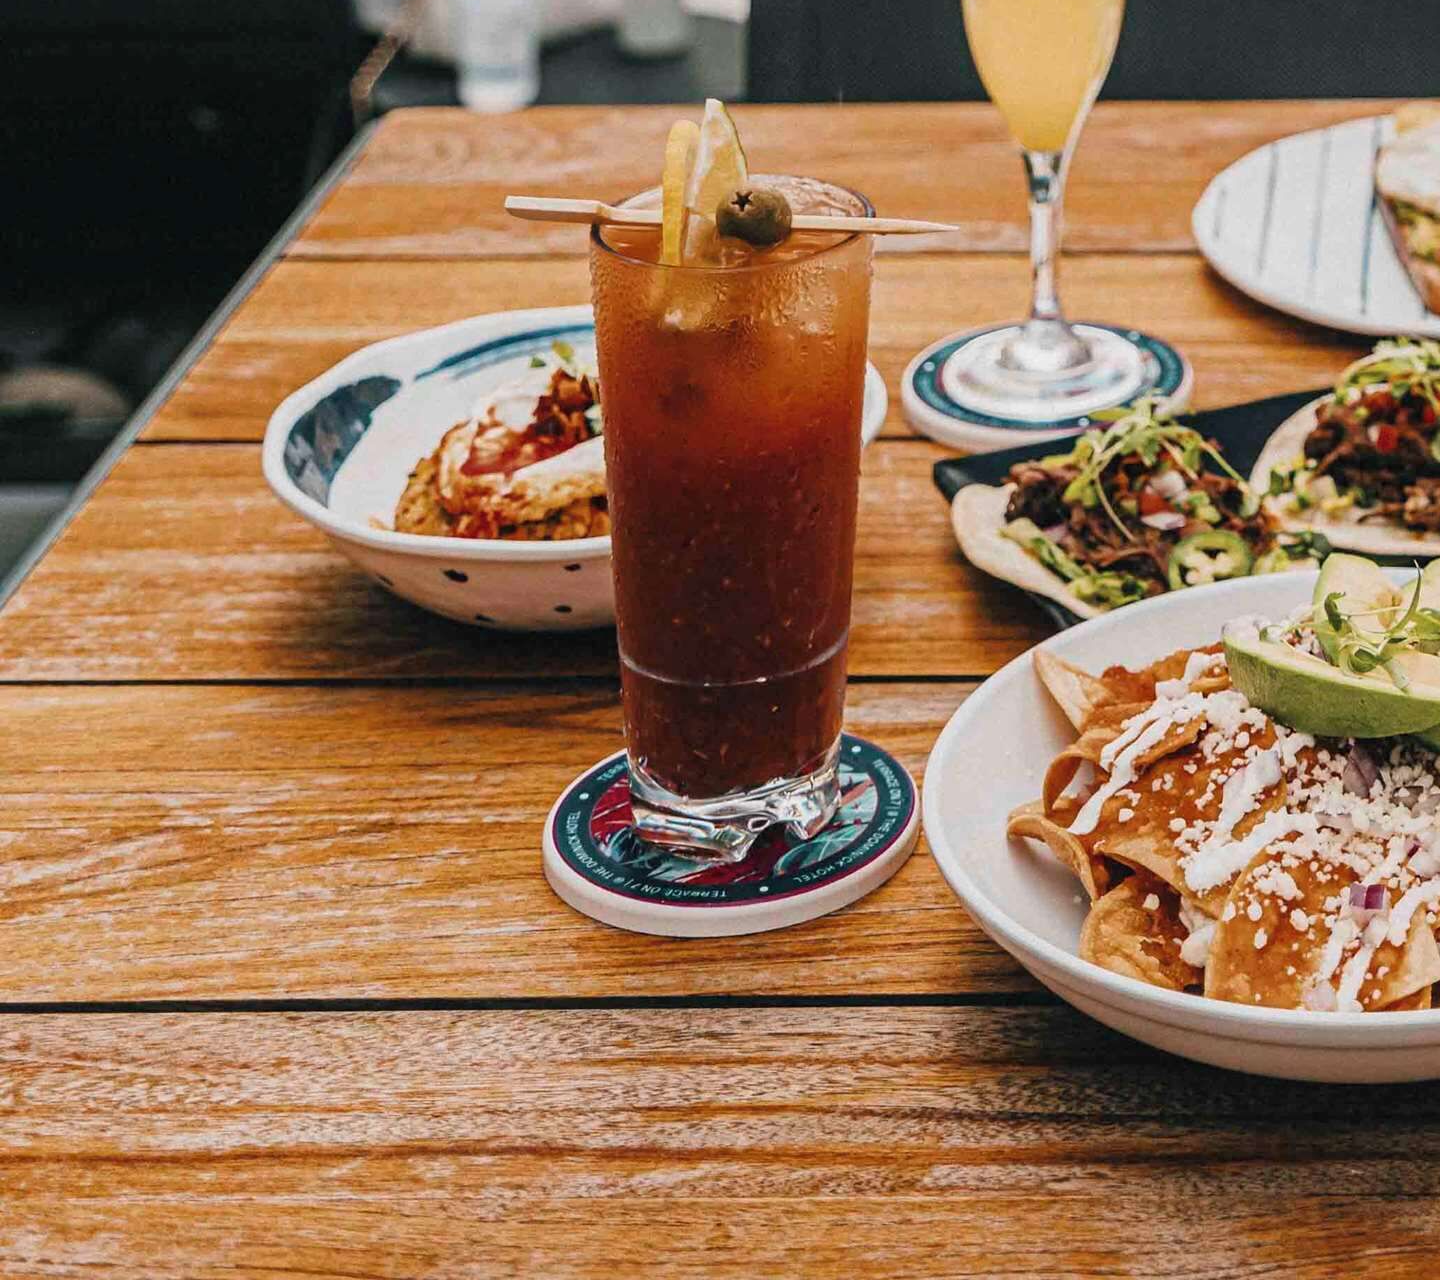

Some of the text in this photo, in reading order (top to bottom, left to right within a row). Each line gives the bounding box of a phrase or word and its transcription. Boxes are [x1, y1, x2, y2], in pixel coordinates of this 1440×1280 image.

[565, 810, 581, 835] HOTEL
[878, 819, 897, 833] THE
[567, 832, 596, 868] DOMINICK
[838, 831, 885, 866] DOMINICK
[594, 865, 615, 880] THE
[792, 866, 835, 883] HOTEL
[640, 884, 661, 895] ON
[663, 887, 728, 899] TERRACE
